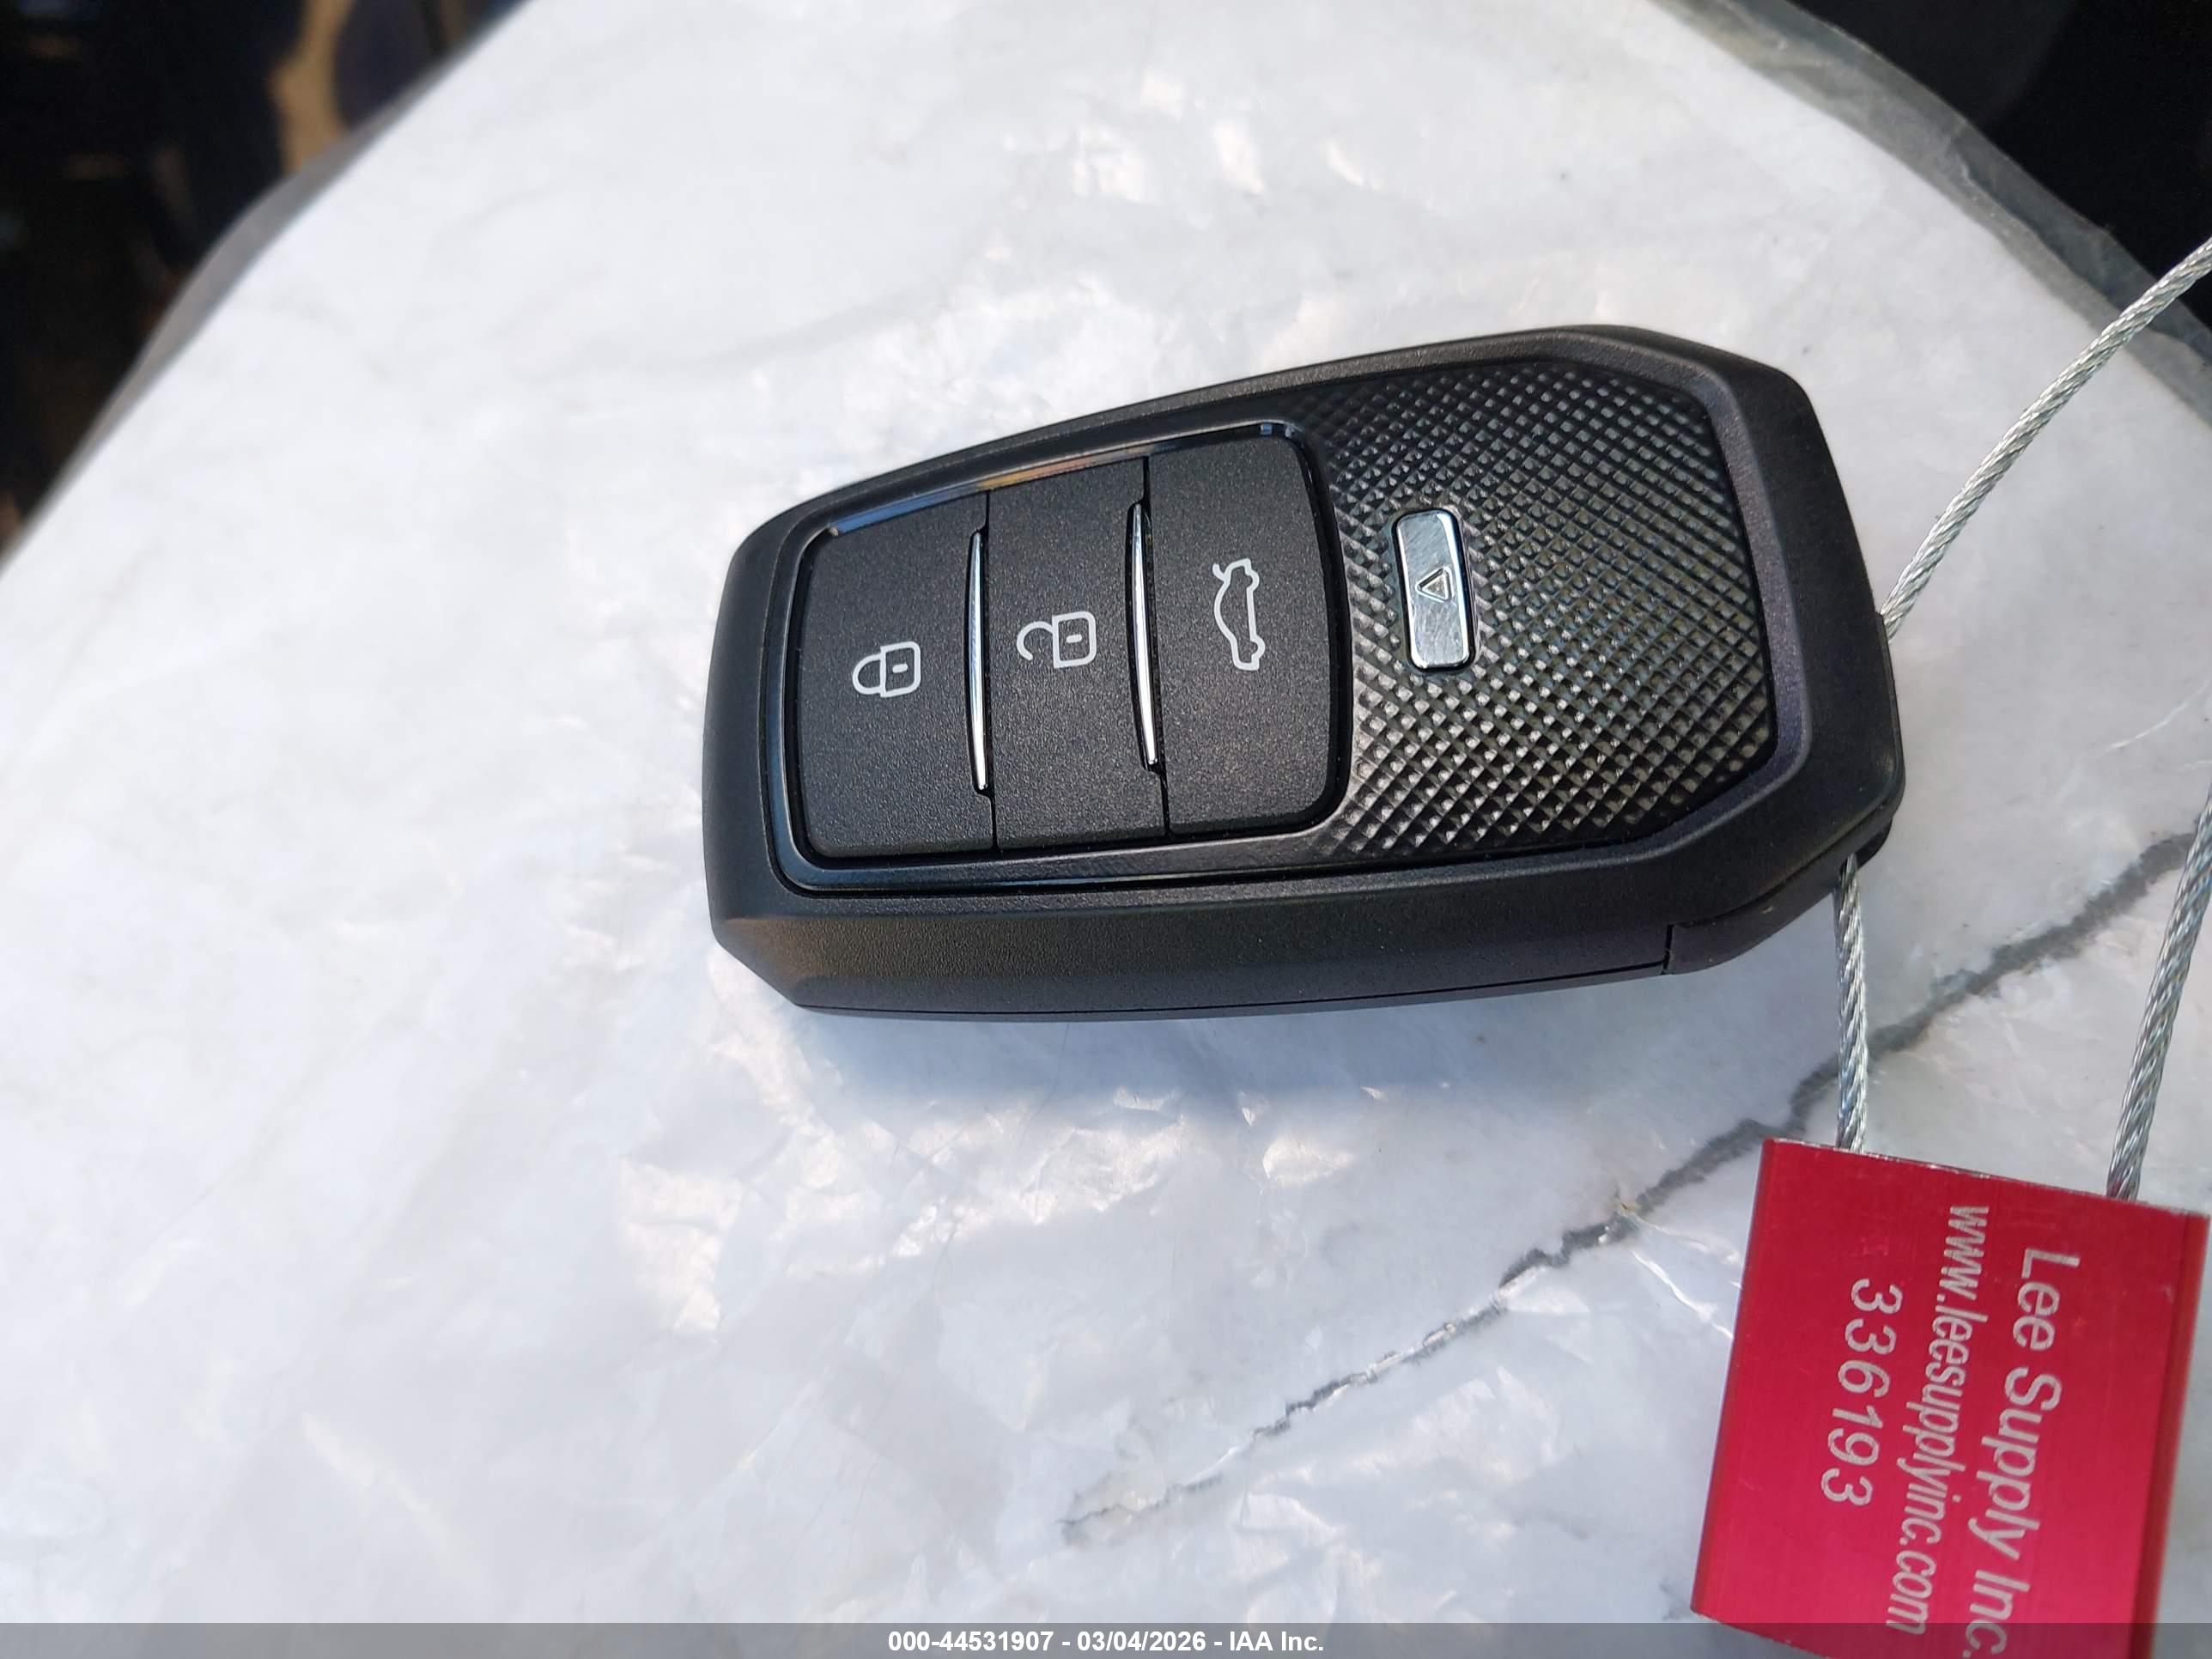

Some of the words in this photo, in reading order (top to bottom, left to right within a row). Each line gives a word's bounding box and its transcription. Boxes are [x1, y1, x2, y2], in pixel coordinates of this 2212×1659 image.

[1820, 1278, 1904, 1506] 336193
[2012, 1248, 2081, 1351] Lee
[1885, 1205, 1990, 1636] www.leesupplyinc.com
[1968, 1366, 2062, 1561] Supply
[1962, 1570, 2031, 1659] Inc.
